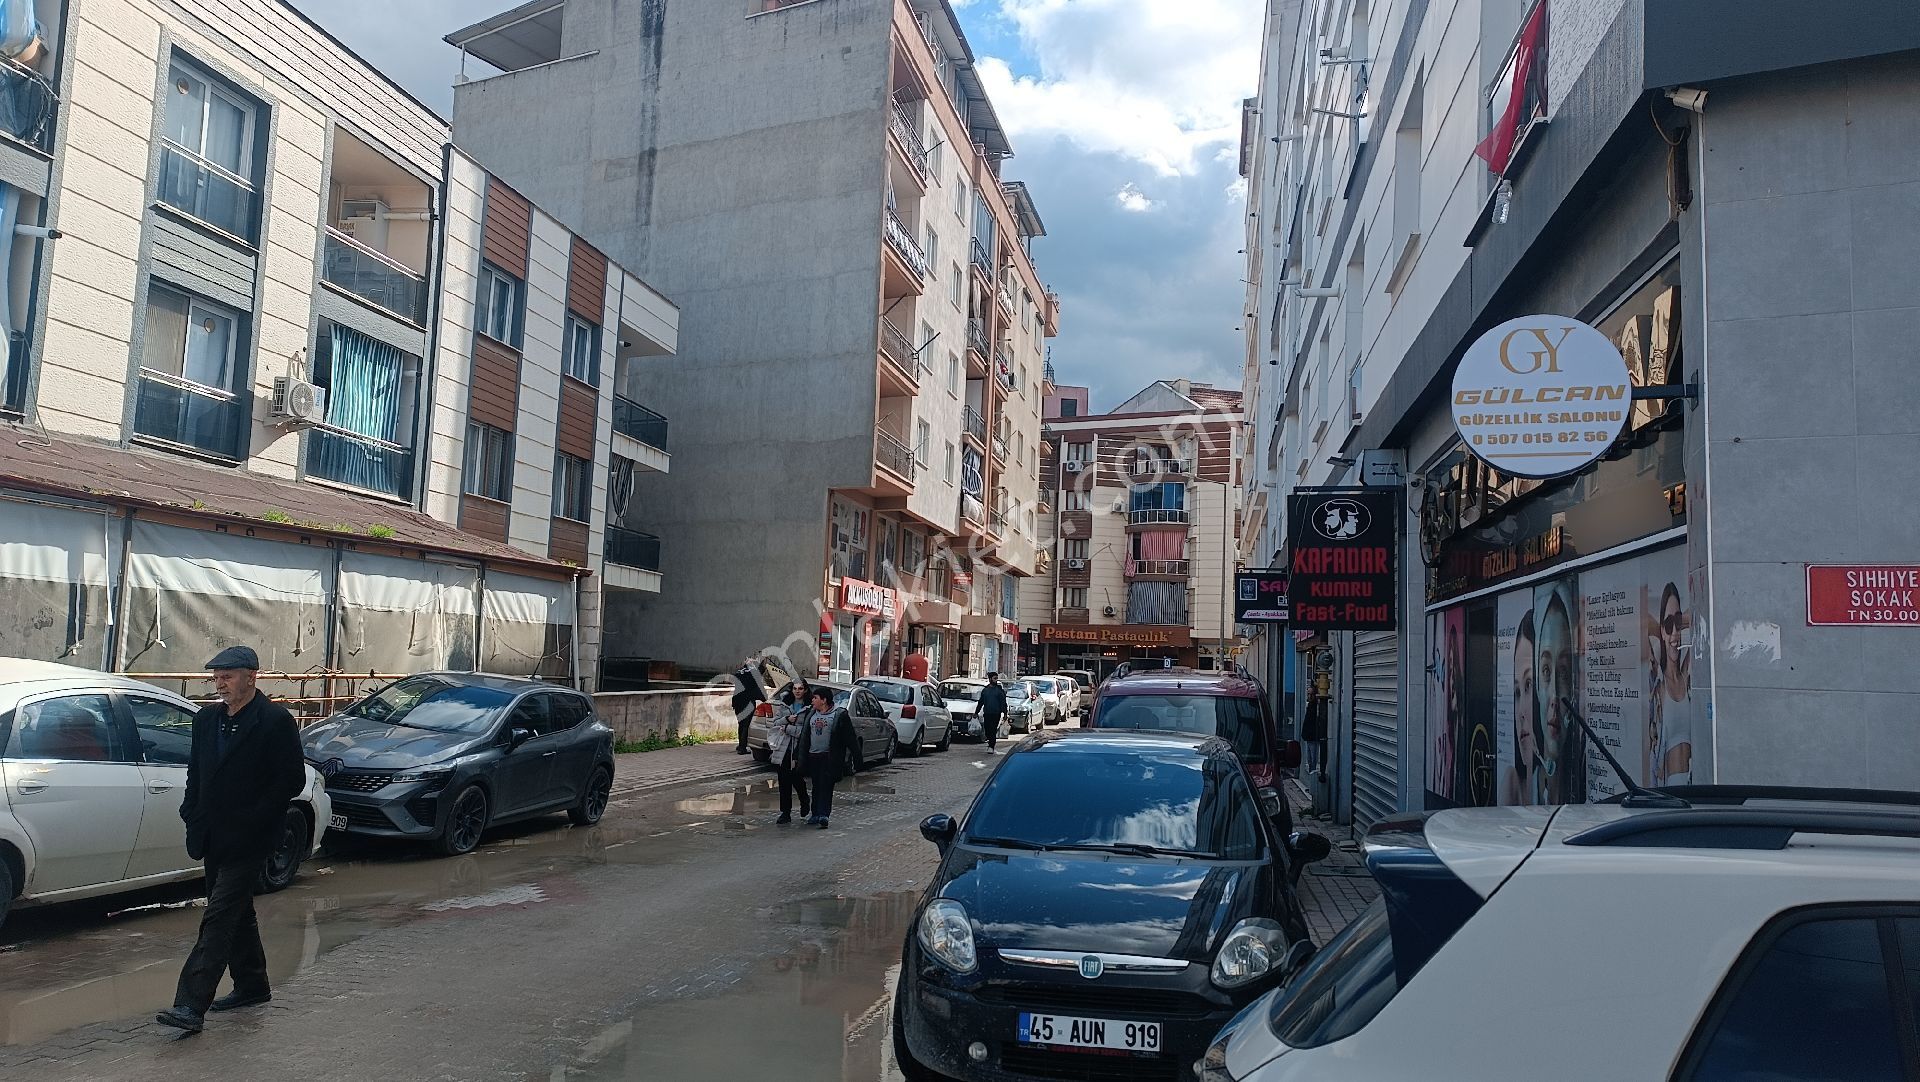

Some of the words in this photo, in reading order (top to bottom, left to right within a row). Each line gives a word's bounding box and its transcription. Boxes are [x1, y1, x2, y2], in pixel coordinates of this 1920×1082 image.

[1500, 327, 1576, 374] GY
[1454, 385, 1626, 405] GÜLCAN
[1459, 412, 1543, 426] GÜZELLİK
[1547, 411, 1622, 423] SALONU
[1472, 434, 1483, 445] 0
[1487, 434, 1518, 445] 507
[1522, 433, 1553, 444] 015
[1558, 431, 1579, 443] 82
[1584, 431, 1608, 442] 56
[1295, 547, 1388, 574] KAFADAR
[1311, 581, 1373, 597] KUMRU
[1851, 590, 1914, 607] SOKAK
[1296, 602, 1388, 622] Fast-Food
[1044, 626, 1098, 640] Pastam
[1084, 961, 1100, 974] FIAT
[1030, 1016, 1053, 1040] 45
[1069, 1020, 1106, 1045] AUN
[1125, 1024, 1158, 1049] 919
